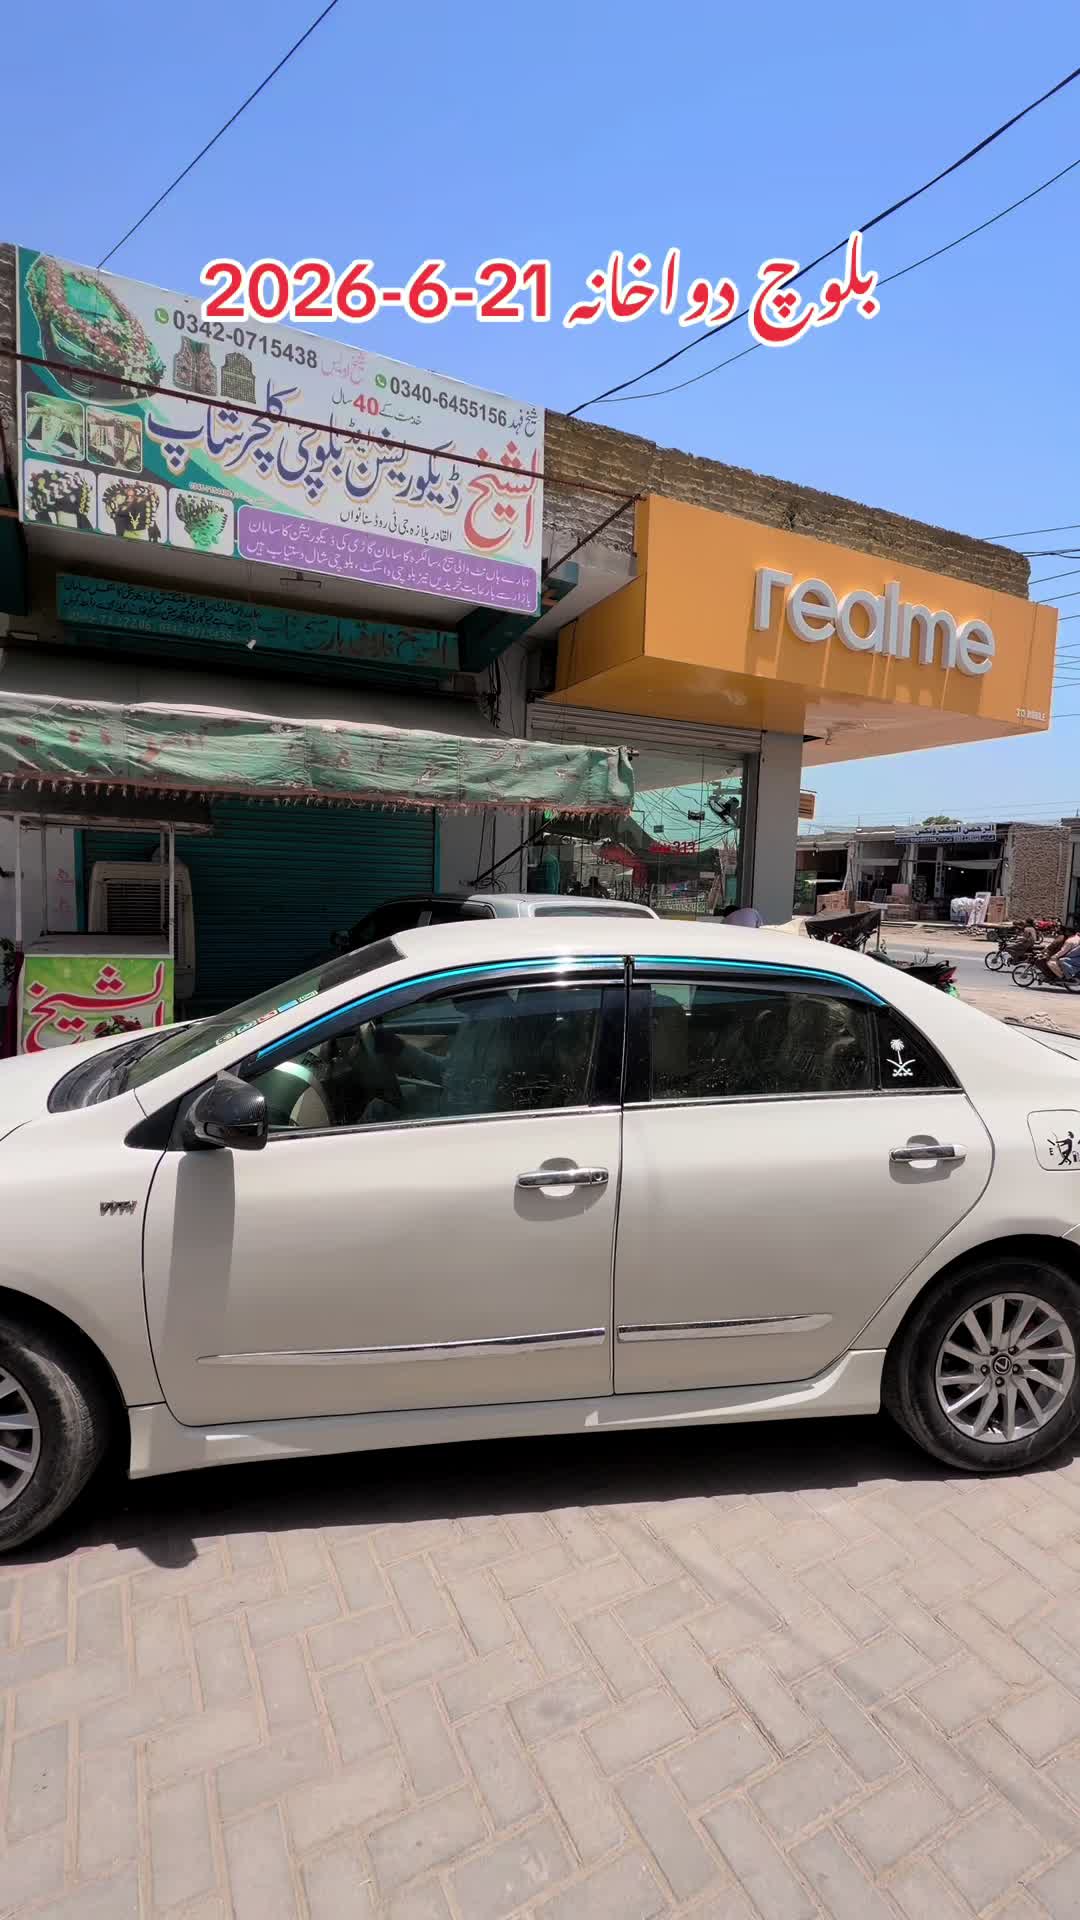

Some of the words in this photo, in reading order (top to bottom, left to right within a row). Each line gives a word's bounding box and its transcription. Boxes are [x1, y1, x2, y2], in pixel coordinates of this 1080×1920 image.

[173, 310, 318, 369] 0342-0715438
[331, 388, 353, 405] سال
[353, 394, 380, 416] 40
[389, 376, 507, 428] 0340-6455156
[464, 440, 538, 549] الشیخ
[753, 566, 997, 677] realme
